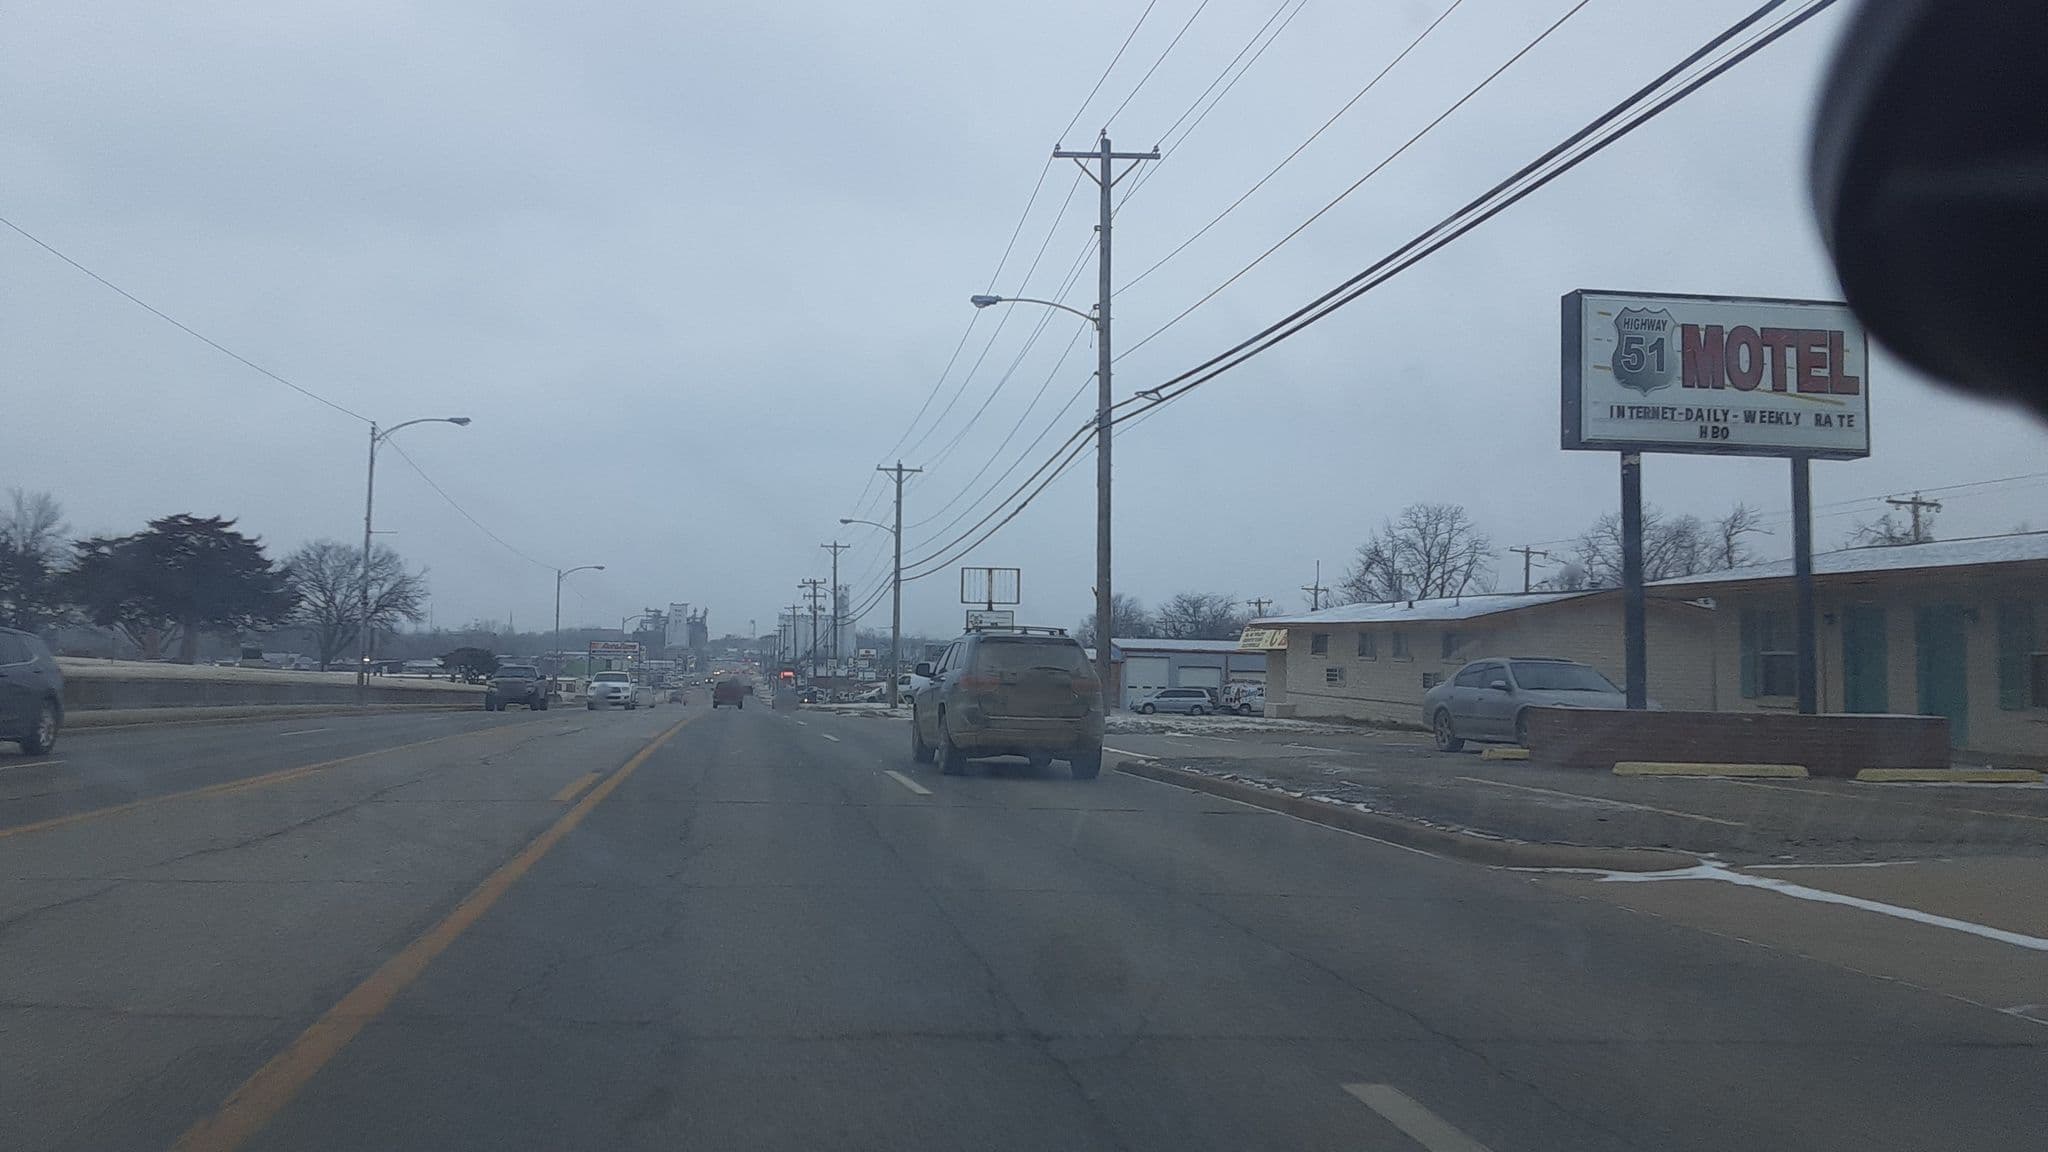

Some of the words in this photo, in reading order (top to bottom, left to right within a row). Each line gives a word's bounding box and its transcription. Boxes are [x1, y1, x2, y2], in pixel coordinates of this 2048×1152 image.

[1623, 317, 1668, 332] HIGHWAY
[1620, 335, 1666, 374] 51
[1681, 323, 1860, 395] MOTEL
[1814, 413, 1855, 428] RATE
[1699, 425, 1730, 440] HBO
